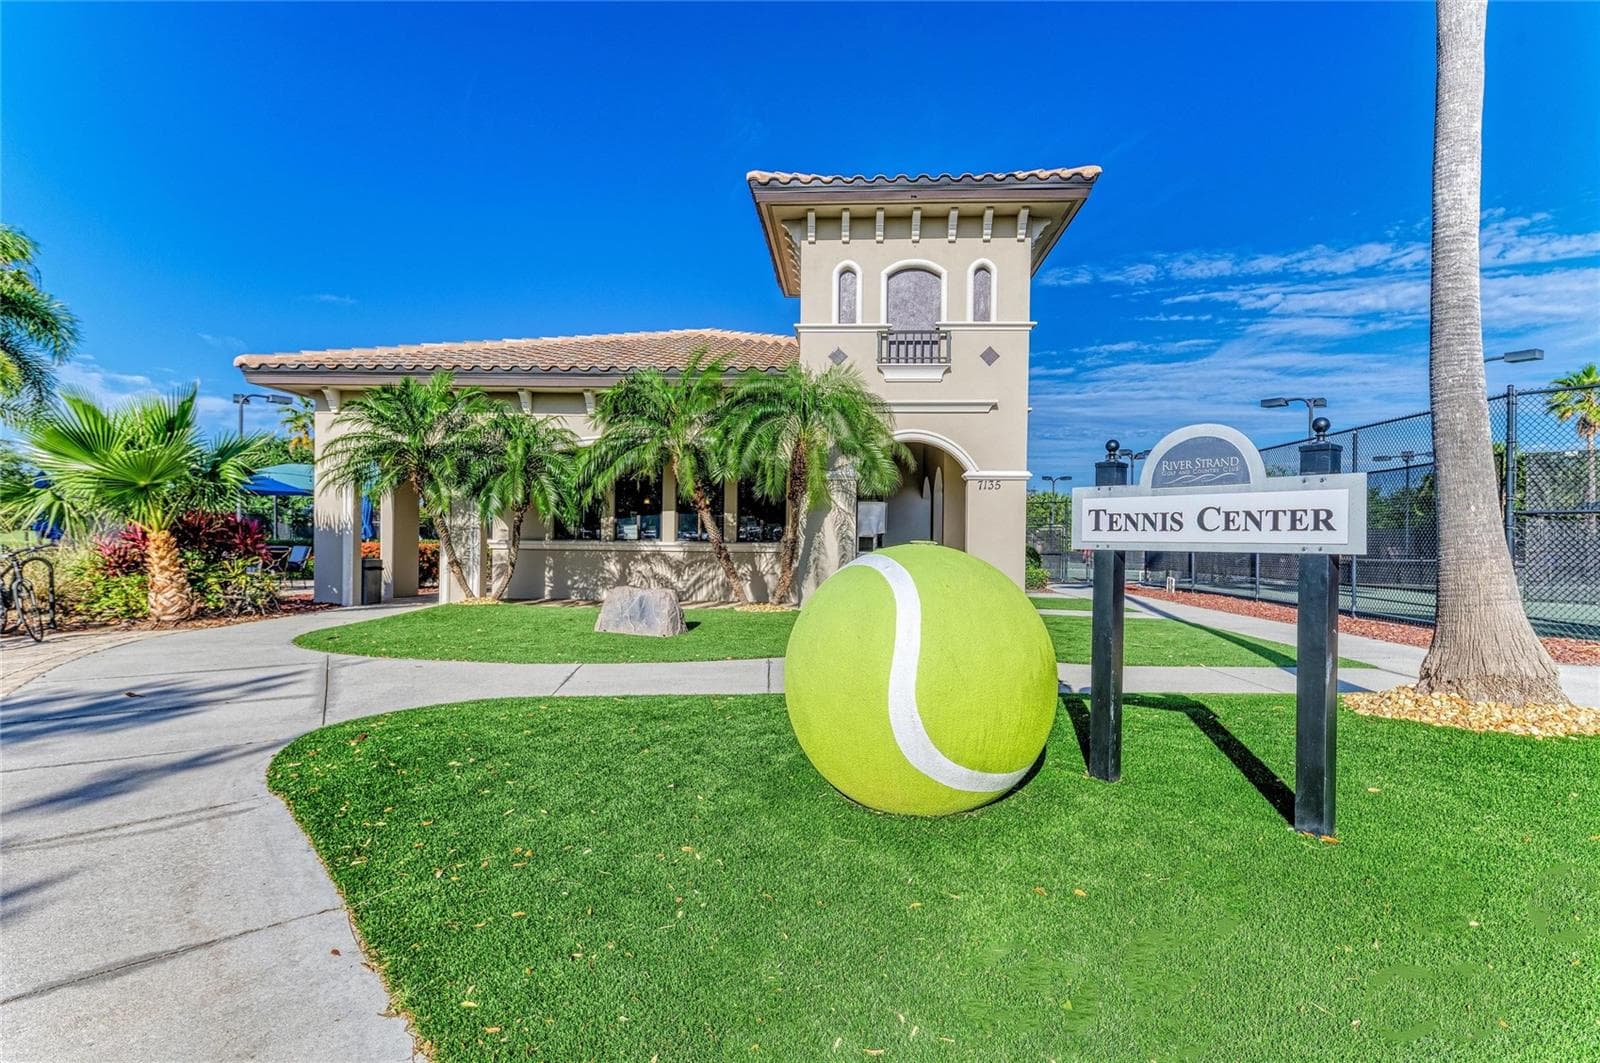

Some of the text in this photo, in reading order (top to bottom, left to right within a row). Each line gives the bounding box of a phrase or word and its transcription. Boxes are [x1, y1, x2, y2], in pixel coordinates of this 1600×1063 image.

[1162, 457, 1239, 470] RIVER STRAND
[977, 480, 1001, 490] 7135
[1088, 506, 1336, 532] TENNIS CENTER
